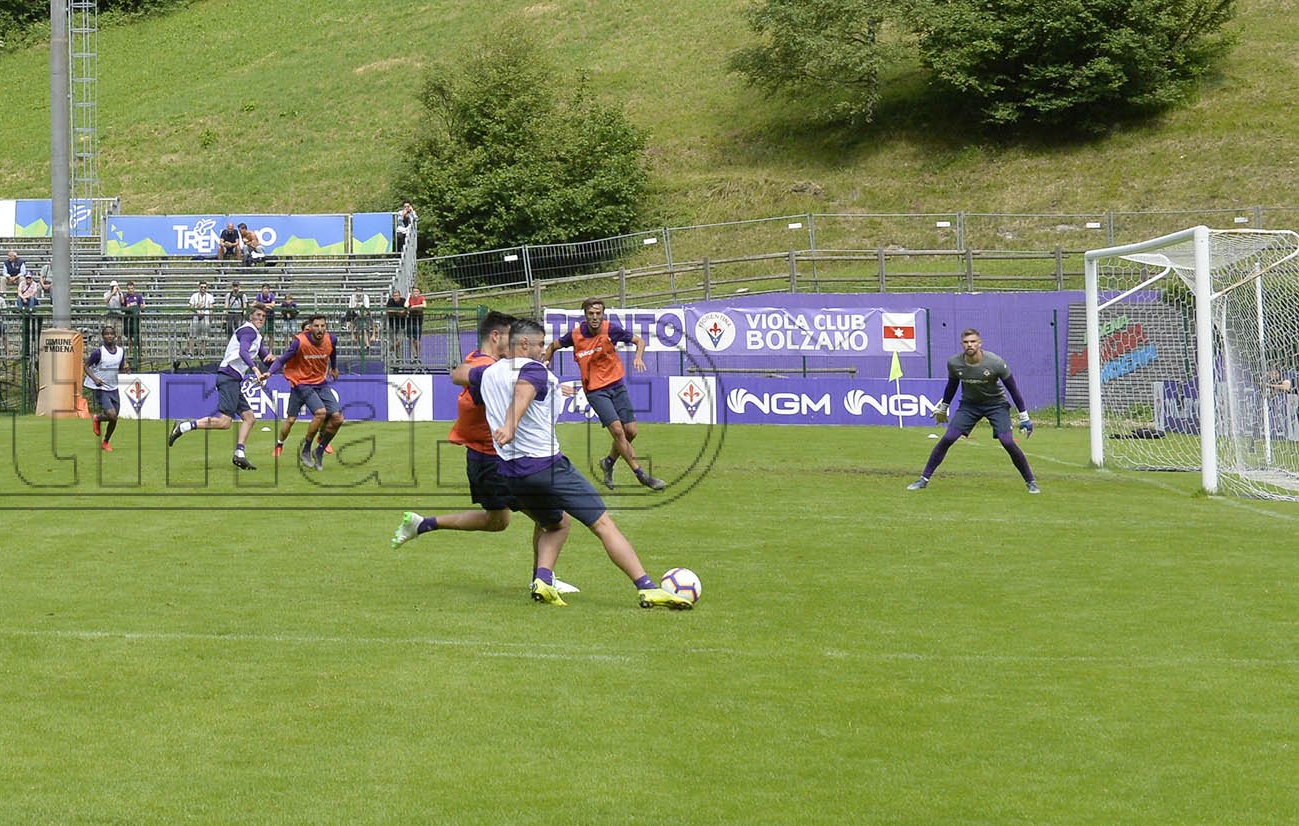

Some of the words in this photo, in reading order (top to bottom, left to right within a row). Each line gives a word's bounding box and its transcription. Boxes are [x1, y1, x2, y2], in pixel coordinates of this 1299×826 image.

[745, 313, 810, 330] VIOLA
[814, 313, 866, 330] CLUB
[746, 330, 869, 351] BOLZANO
